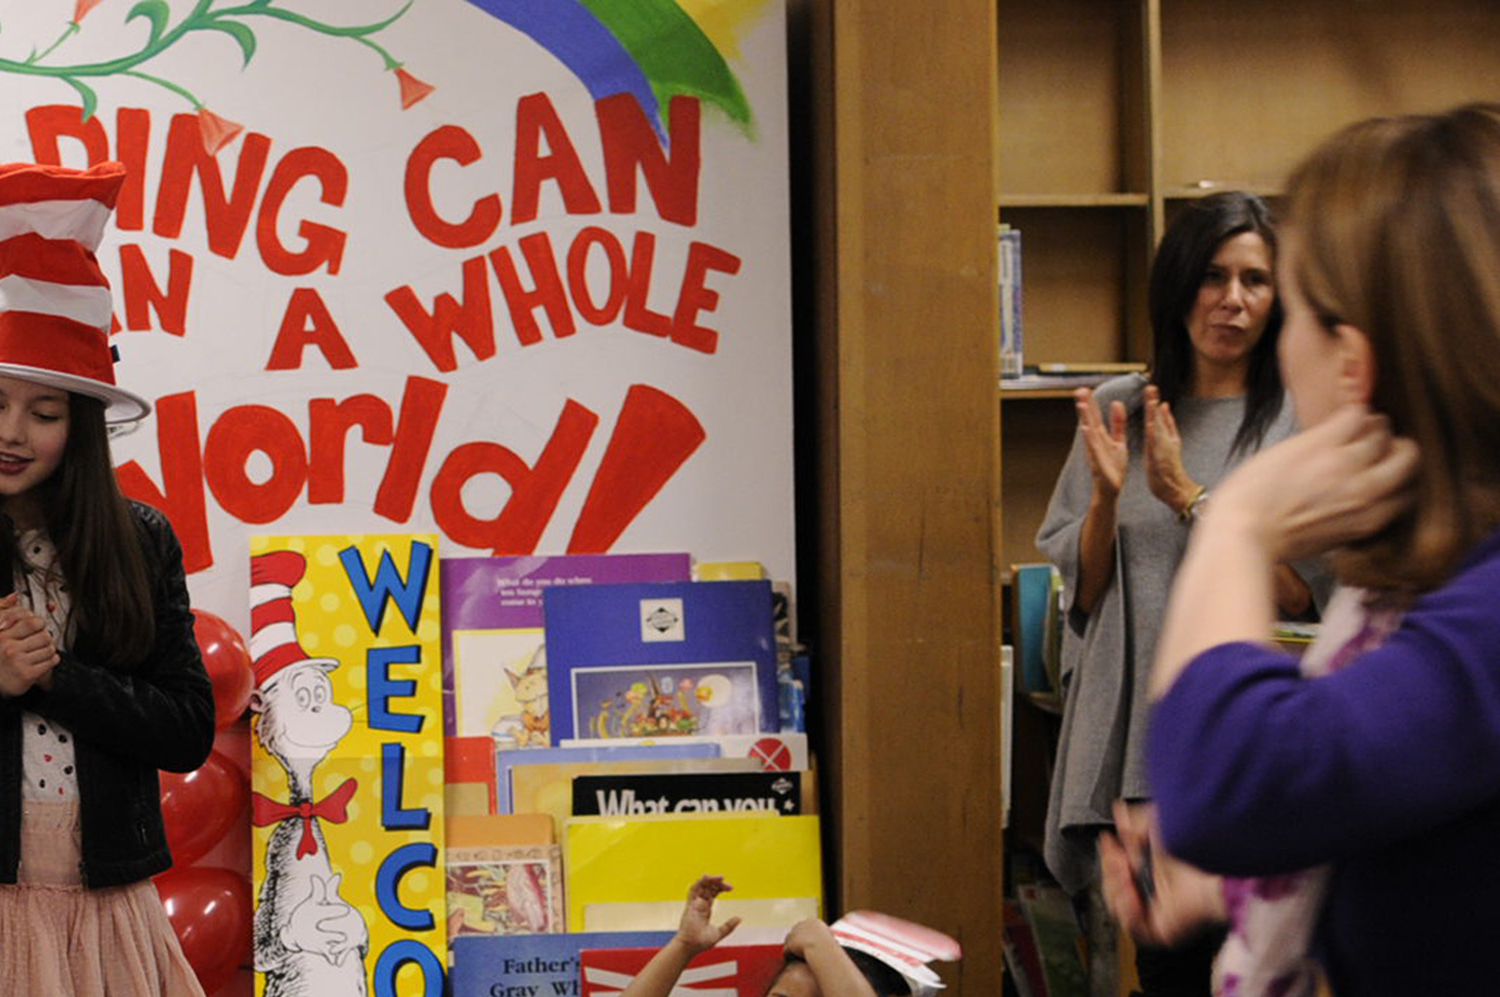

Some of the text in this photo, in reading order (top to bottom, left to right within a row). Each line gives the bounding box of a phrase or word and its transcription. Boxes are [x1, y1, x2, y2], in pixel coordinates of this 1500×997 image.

[404, 91, 699, 249] CAN
[265, 287, 358, 370] A
[383, 226, 741, 372] WHOLE
[596, 789, 669, 816] What
